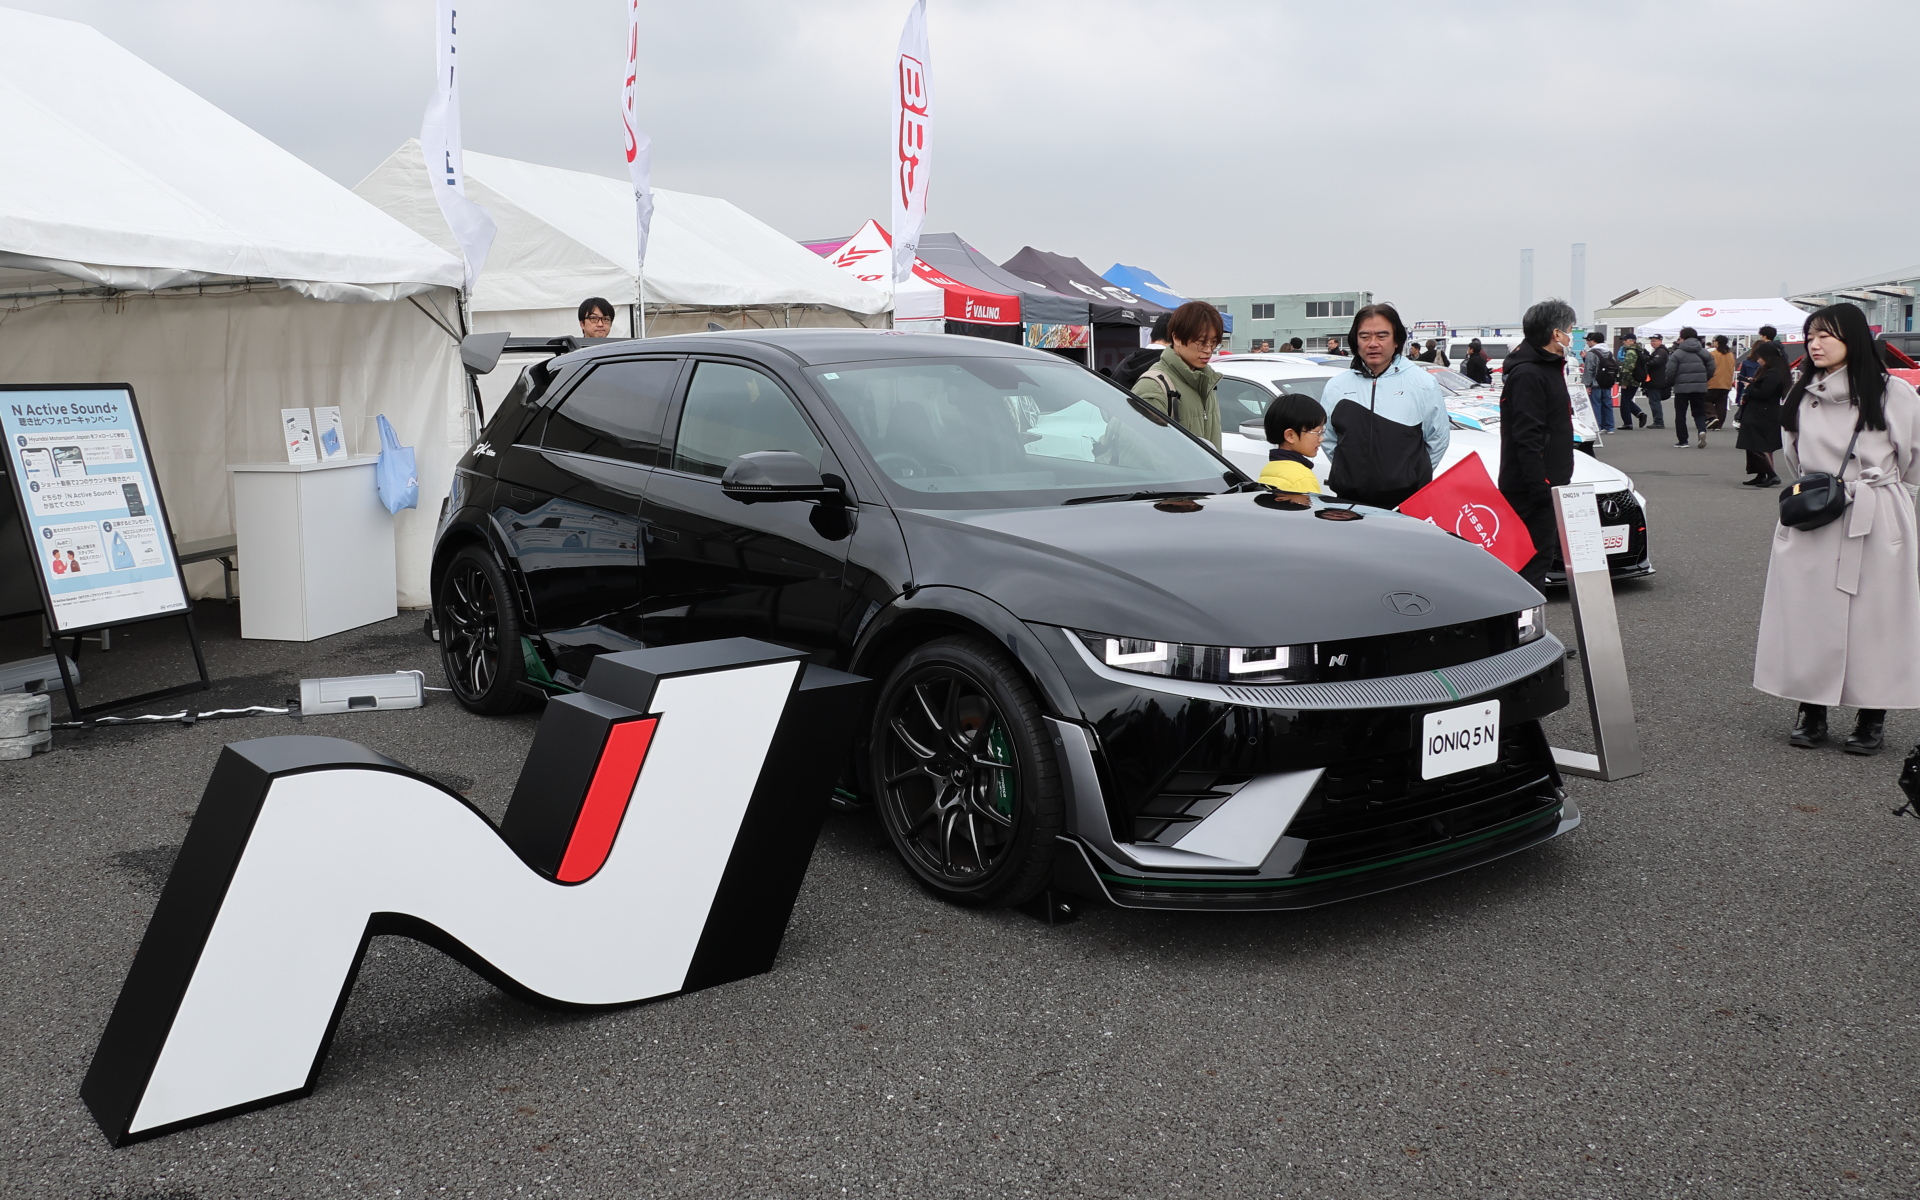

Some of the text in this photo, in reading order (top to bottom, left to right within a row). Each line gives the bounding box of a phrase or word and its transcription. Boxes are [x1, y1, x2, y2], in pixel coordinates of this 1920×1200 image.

[11, 402, 118, 416] N Active Sound+
[73, 490, 92, 498] Active
[1462, 504, 1494, 548] NISSAN
[1428, 723, 1495, 756] IONIQ 5 N
